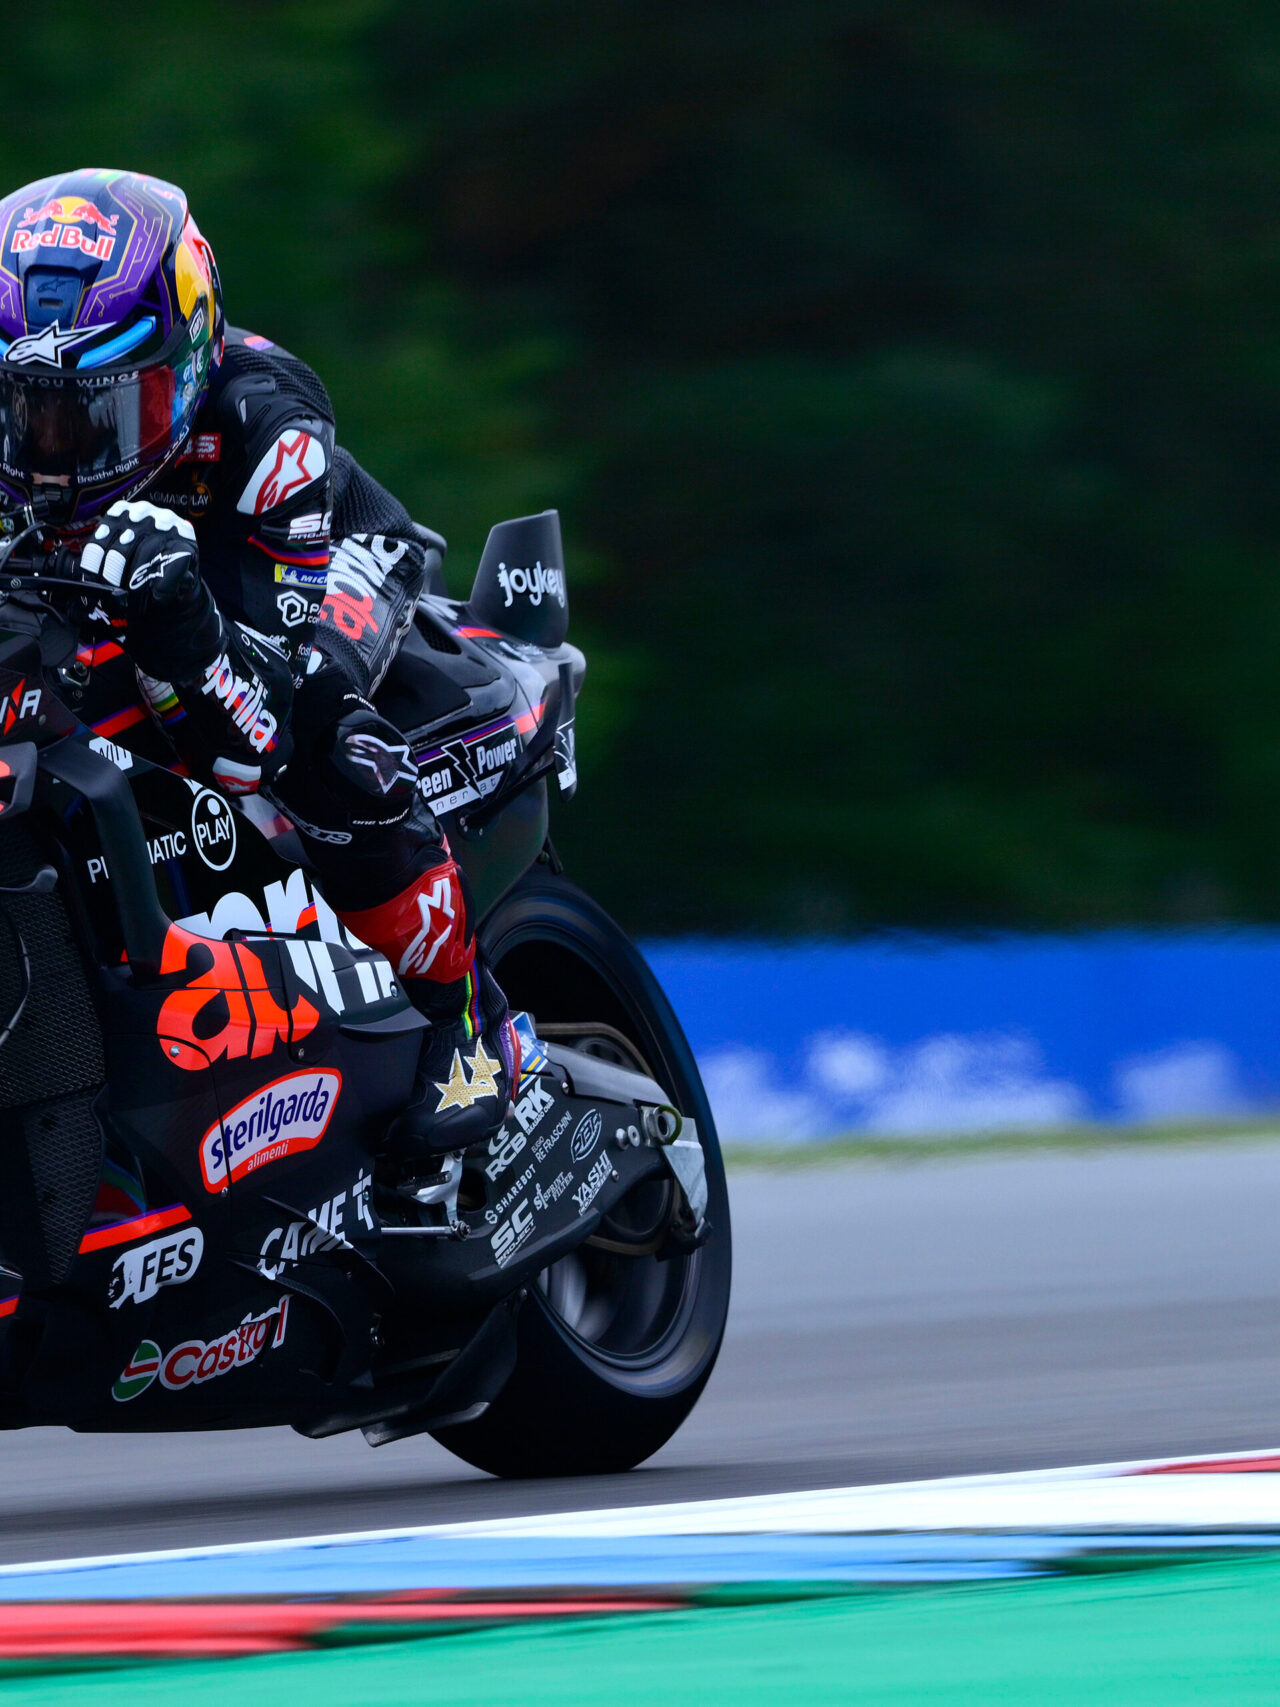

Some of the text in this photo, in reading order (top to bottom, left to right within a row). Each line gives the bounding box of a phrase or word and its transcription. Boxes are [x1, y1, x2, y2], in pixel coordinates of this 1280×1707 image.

[10, 224, 116, 261] Red Bull
[27, 376, 64, 387] YOU
[76, 370, 140, 387] WINGS
[3, 463, 25, 479] Right
[77, 457, 140, 484] Breathe Right
[497, 561, 565, 608] joykey
[476, 738, 517, 775] Power
[195, 814, 231, 849] PLAY
[211, 1078, 329, 1169] sterilgarda
[514, 1077, 553, 1132] RK
[247, 1140, 289, 1171] alimenti
[485, 1132, 527, 1182] RCB
[496, 1163, 536, 1214] SHAREBOT
[544, 1171, 564, 1201] SPRINT
[552, 1172, 574, 1202] FILTER
[572, 1149, 613, 1207] YASHI
[491, 1198, 533, 1258] SC
[497, 1219, 535, 1266] PROJECT
[162, 1297, 290, 1387] Castrol
